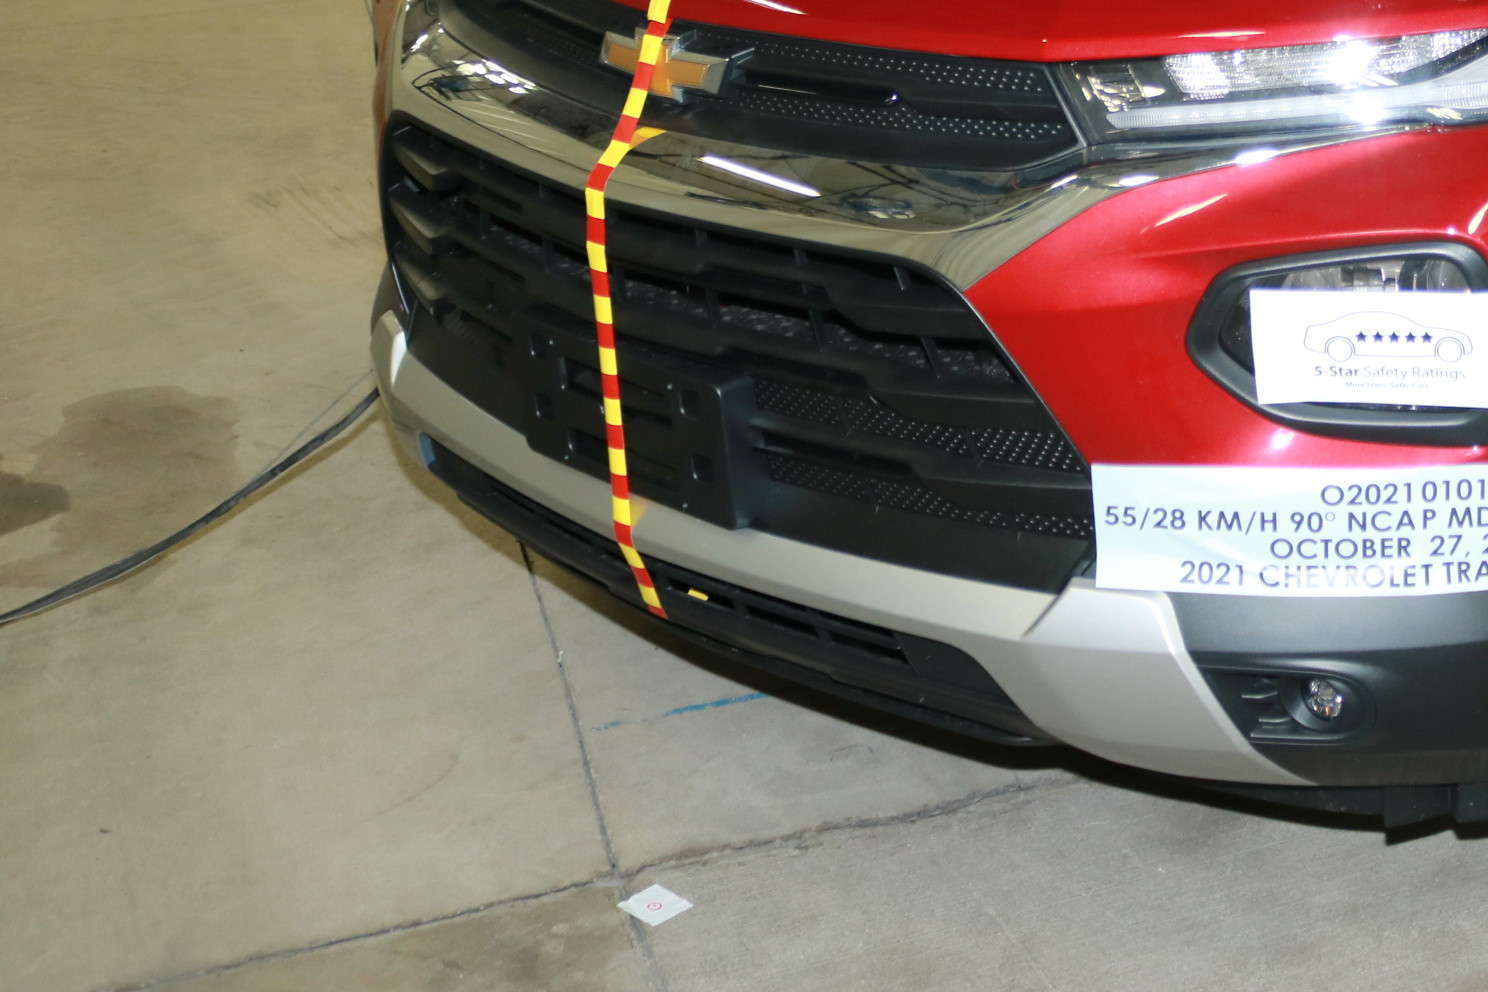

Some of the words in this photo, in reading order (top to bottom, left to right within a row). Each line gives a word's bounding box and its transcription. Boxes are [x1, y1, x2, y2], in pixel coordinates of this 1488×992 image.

[1314, 365, 1360, 377] 5-Star
[1363, 366, 1408, 381] Safety
[1412, 366, 1466, 382] Ratings
[1345, 381, 1364, 389] More
[1320, 478, 1486, 506] O20210101
[1104, 505, 1186, 531] 55/28
[1197, 509, 1278, 535] KM/H
[1290, 511, 1336, 533] 90°
[1347, 508, 1437, 533] NCAP
[1270, 537, 1412, 560] OCTOBER
[1429, 534, 1470, 558] 27,
[1179, 560, 1244, 586] 2021
[1259, 563, 1433, 588] CHEVROLET
